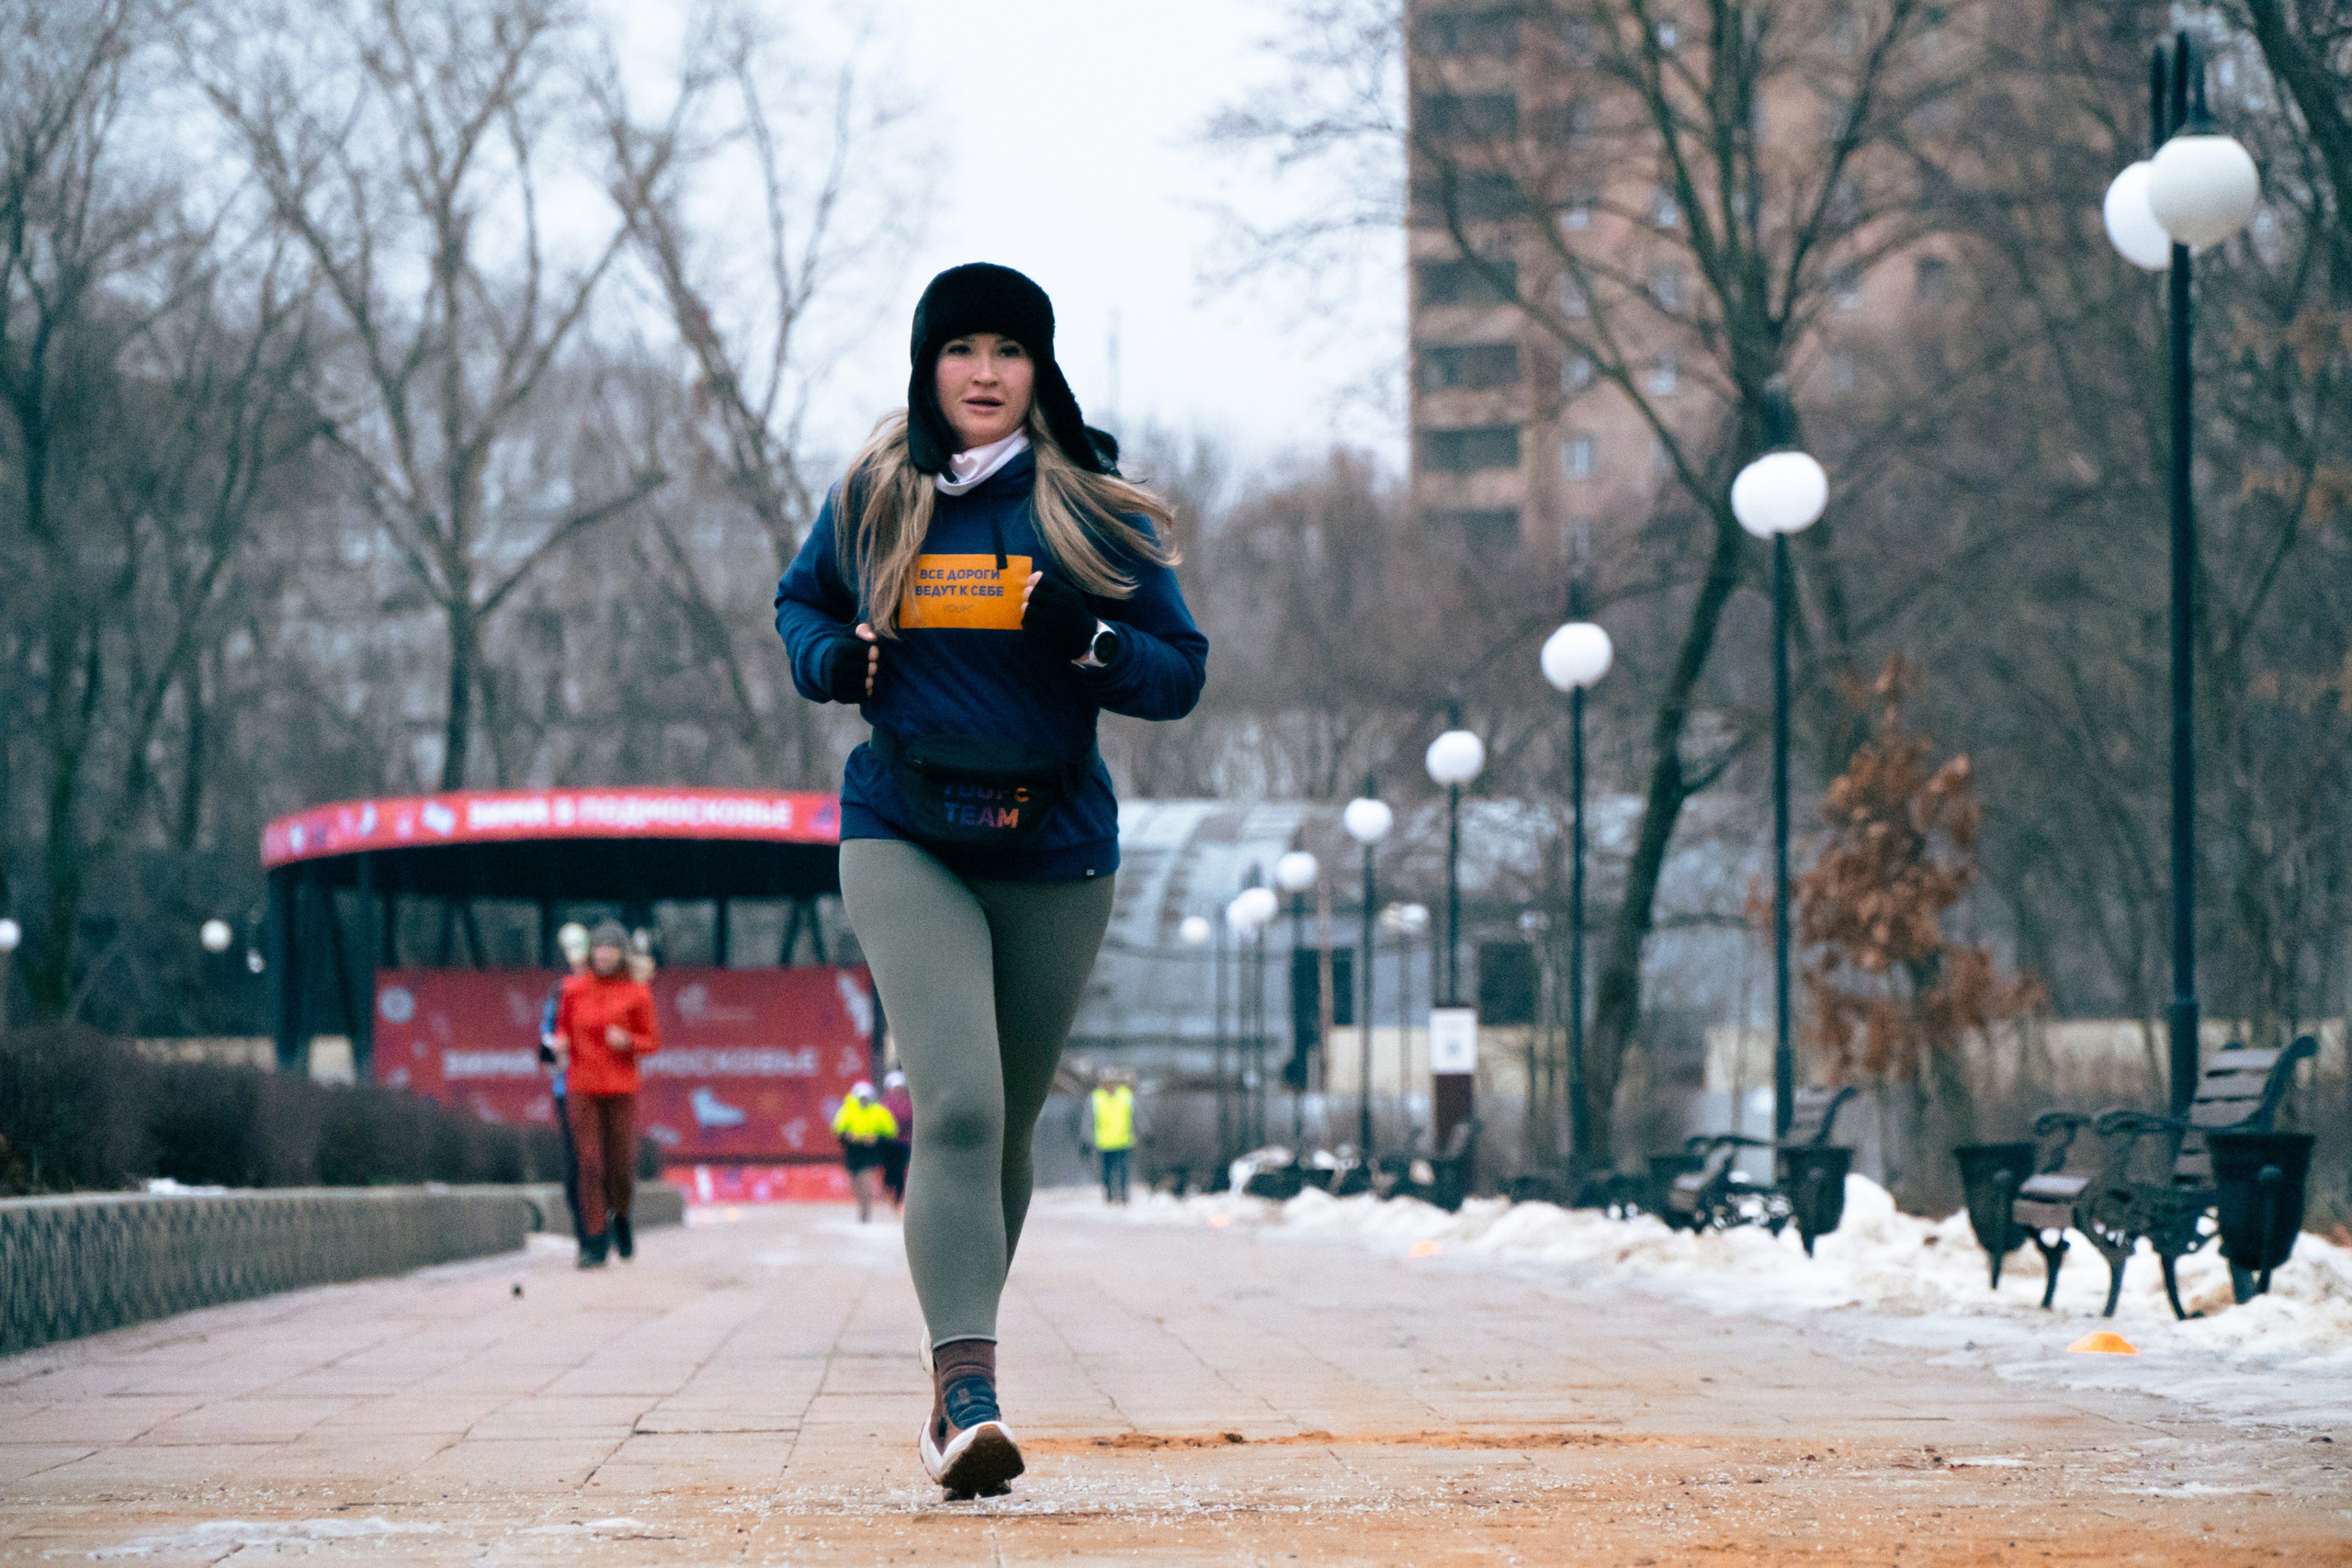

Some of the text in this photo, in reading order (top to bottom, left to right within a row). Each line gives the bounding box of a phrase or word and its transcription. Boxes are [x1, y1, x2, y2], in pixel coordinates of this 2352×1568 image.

[920, 569, 1001, 581] ВСЕ ДОРОГИ
[915, 585, 1004, 597] ВЕДУТ К СЕБЕ
[944, 802, 1020, 829] TEAM
